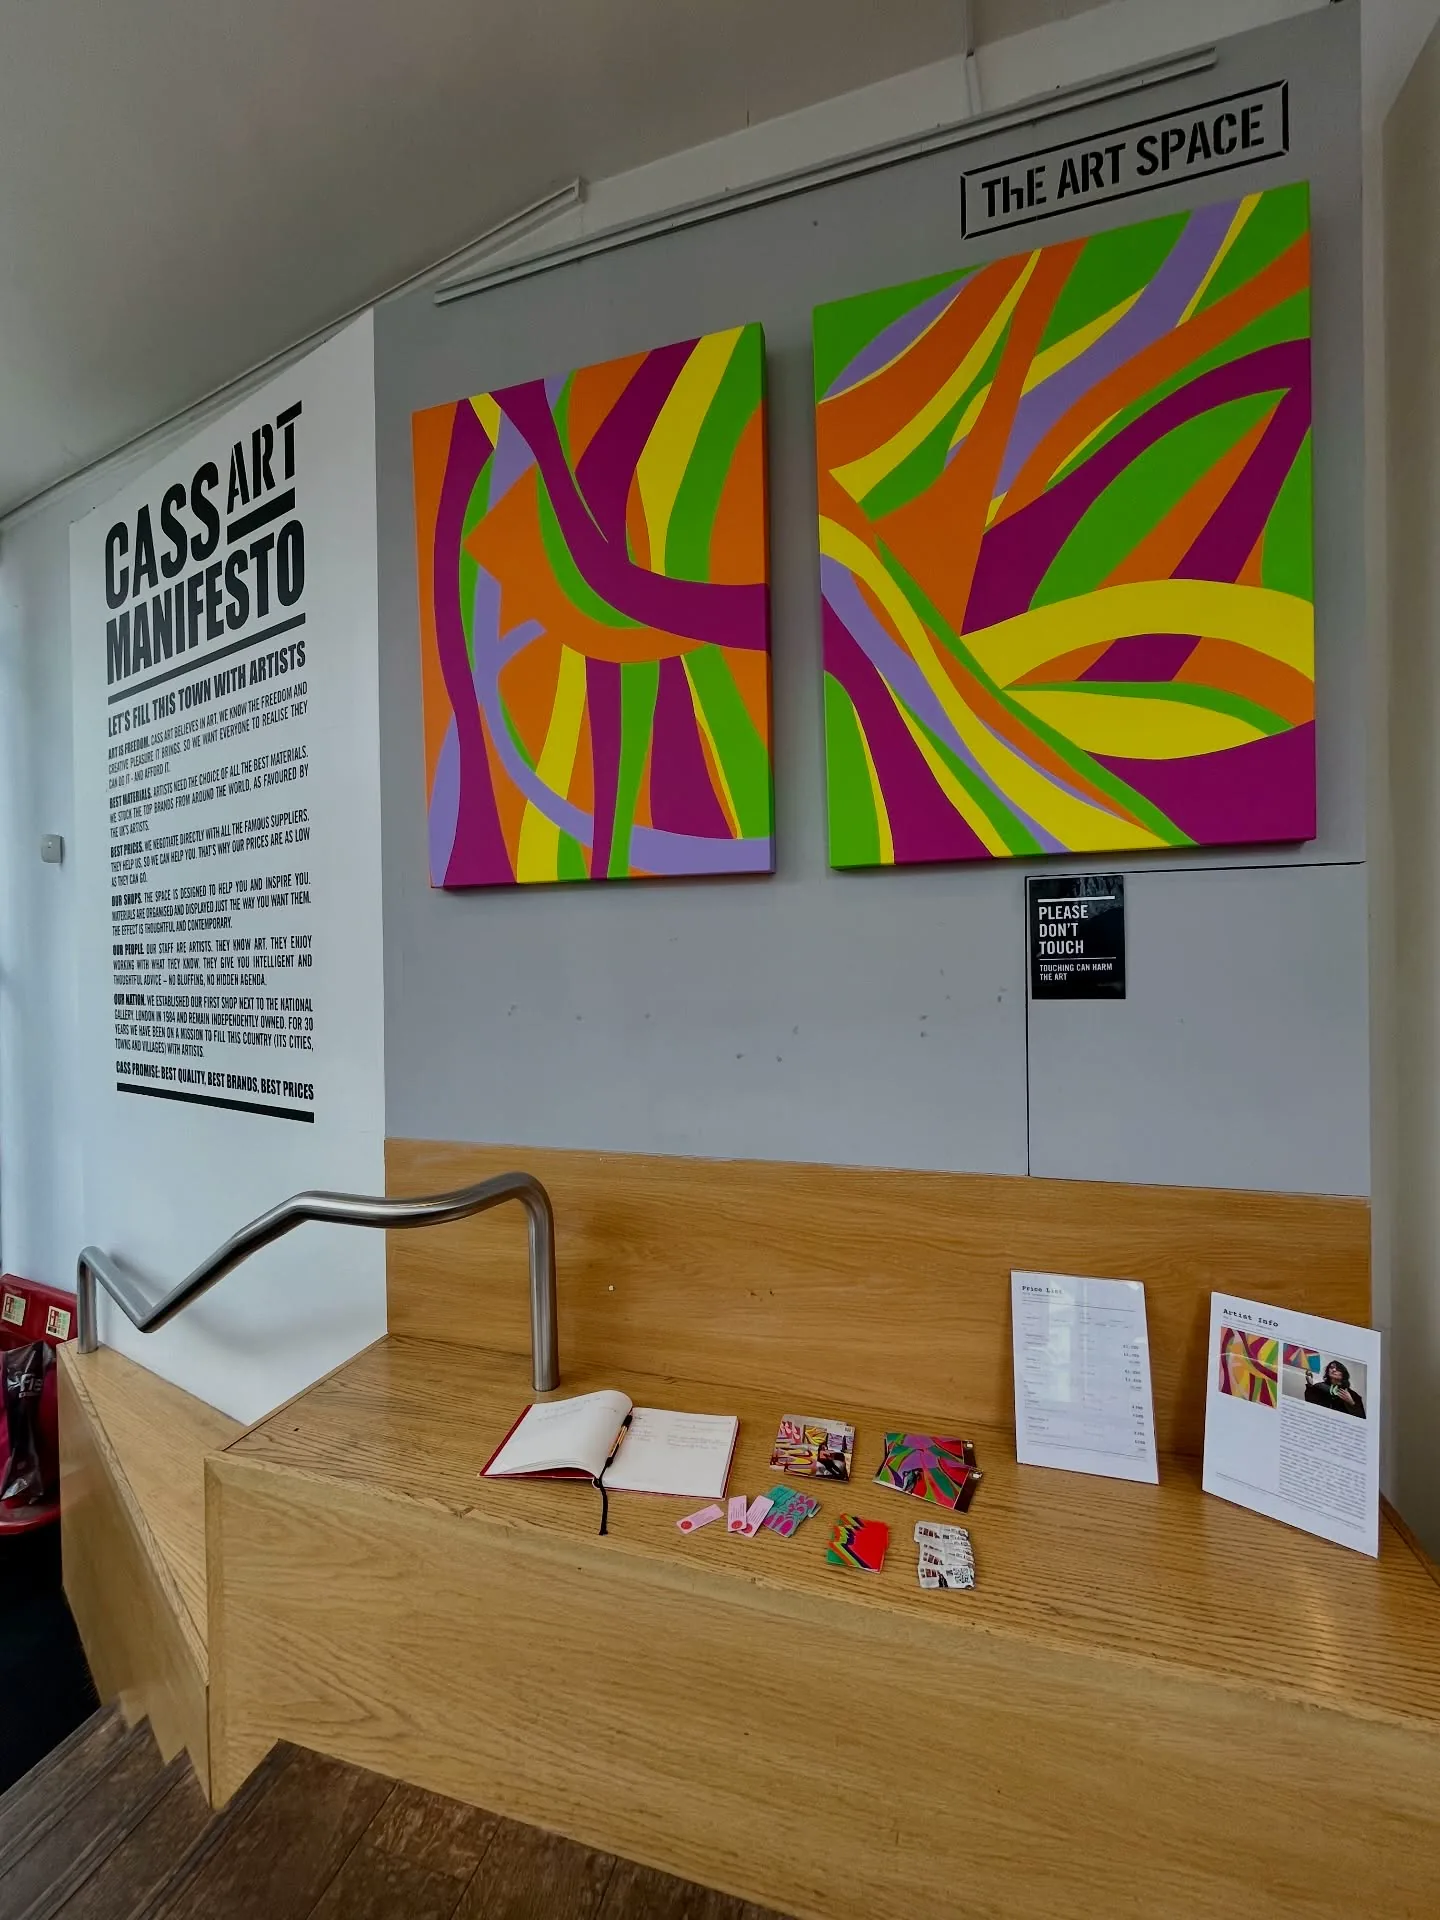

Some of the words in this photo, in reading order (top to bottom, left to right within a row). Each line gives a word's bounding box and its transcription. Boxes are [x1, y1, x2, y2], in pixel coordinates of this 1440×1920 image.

[1057, 143, 1126, 200] ART
[1136, 103, 1265, 177] SPACE
[105, 461, 220, 610] CASS
[227, 400, 303, 515] ART
[106, 519, 305, 685] MANIFESTO
[108, 709, 131, 738] LET'S
[132, 701, 151, 729] FILL
[152, 691, 176, 722] THIS
[178, 677, 211, 712] TOWN
[214, 663, 246, 699] WITH
[249, 639, 306, 686] ARTISTS
[174, 719, 199, 739] BELIEVES
[200, 716, 206, 730] IN
[218, 708, 229, 723] WE
[229, 702, 248, 720] KNOW
[248, 697, 260, 714] THE
[261, 686, 292, 709] FREEDOM
[293, 680, 308, 698] AND
[183, 738, 191, 752] SO
[220, 718, 250, 740] EVERYONE
[252, 715, 260, 730] TO
[262, 706, 289, 727] REALISE
[291, 699, 308, 718] THEY
[174, 777, 188, 793] NEED
[188, 774, 198, 789] THE
[199, 768, 220, 786] CHOICE
[221, 766, 229, 780] OF
[229, 763, 240, 778] ALL
[241, 759, 252, 775] THE
[254, 755, 269, 772] BEST
[270, 744, 309, 767] MATERIALS.
[175, 793, 190, 808] FROM
[192, 787, 214, 805] AROUND
[216, 784, 227, 799] THE
[228, 778, 252, 796] WORLD,
[253, 775, 262, 790] AS
[263, 766, 297, 787] FAVOURED
[300, 763, 309, 778] BY
[180, 829, 205, 845] DIRECTLY
[205, 826, 220, 840] WITH
[221, 824, 231, 838] ALL
[232, 821, 243, 835] THE
[244, 816, 270, 833] FAMOUS
[270, 808, 310, 828] SUPPLIERS.
[171, 849, 184, 863] HELP
[198, 843, 216, 859] THAT'S
[217, 841, 231, 855] WHY
[232, 838, 244, 853] OUR
[246, 834, 269, 851] PRICES
[270, 831, 283, 846] ARE
[285, 829, 293, 844] AS
[295, 826, 310, 842] LOW
[172, 888, 179, 900] IS
[180, 885, 207, 899] DESIGNED
[209, 883, 216, 896] TO
[218, 881, 233, 895] HELP
[235, 879, 248, 893] YOU
[250, 877, 263, 891] AND
[266, 874, 292, 889] INSPIRE
[295, 871, 311, 886] YOU.
[173, 904, 185, 916] AND
[185, 900, 214, 915] DISPLAYED
[214, 899, 228, 912] JUST
[229, 897, 241, 911] THE
[242, 896, 255, 910] WAY
[256, 895, 269, 908] YOU
[270, 893, 289, 907] WANT
[291, 890, 311, 905] THEM.
[1039, 905, 1089, 920] PLEASE
[176, 920, 187, 932] AND
[1039, 923, 1079, 937] DON'T
[176, 941, 187, 954] ARE
[215, 939, 230, 952] THEY
[233, 938, 251, 951] KNOW
[254, 937, 268, 951] ART.
[270, 936, 288, 950] THEY
[291, 935, 312, 949] ENJOY
[1039, 940, 1084, 955] TOUCH
[167, 958, 181, 970] THEY
[203, 956, 218, 969] THEY
[220, 956, 234, 969] GIVE
[237, 956, 250, 968] YOU
[253, 954, 294, 968] INTELLIGENT
[298, 954, 312, 967] AND
[1040, 964, 1074, 972] TOUCHING
[1076, 963, 1090, 971] CAN
[1092, 963, 1113, 971] HARM
[169, 974, 176, 986] NO
[206, 974, 215, 986] NO
[216, 973, 239, 986] HIDDEN
[240, 973, 267, 986] AGENDA.
[1040, 973, 1053, 981] THE
[156, 995, 190, 1008] ESTABLISHED
[190, 996, 202, 1008] OUR
[204, 996, 220, 1009] FIRST
[221, 996, 238, 1009] SHOP
[239, 996, 255, 1010] NEXT
[256, 997, 264, 1010] TO
[265, 997, 278, 1011] THE
[280, 997, 313, 1012] NATIONAL
[176, 1011, 187, 1024] AND
[188, 1012, 210, 1025] REMAIN
[211, 1013, 259, 1028] INDEPENDENTLY
[261, 1015, 287, 1029] OWNED.
[289, 1016, 302, 1030] FOR
[304, 1017, 313, 1031] 30
[167, 1026, 175, 1039] ON
[176, 1027, 179, 1039] A
[180, 1028, 204, 1041] MISSION
[205, 1029, 212, 1042] TO
[213, 1030, 226, 1043] FILL
[228, 1030, 241, 1044] THIS
[242, 1031, 272, 1047] COUNTRY
[273, 1034, 287, 1048] (ITS
[289, 1034, 314, 1050] CITIES,
[167, 1042, 181, 1055] WITH
[116, 1060, 131, 1075] CASS
[132, 1062, 160, 1079] PROMISE:
[161, 1066, 177, 1081] BEST
[178, 1068, 207, 1085] QUALITY,
[208, 1071, 225, 1088] BEST
[226, 1074, 260, 1093] BRANDS,
[261, 1078, 281, 1096] BEST
[283, 1081, 314, 1100] PRICES
[1223, 1308, 1252, 1321] Artist
[1258, 1317, 1279, 1327] Info
